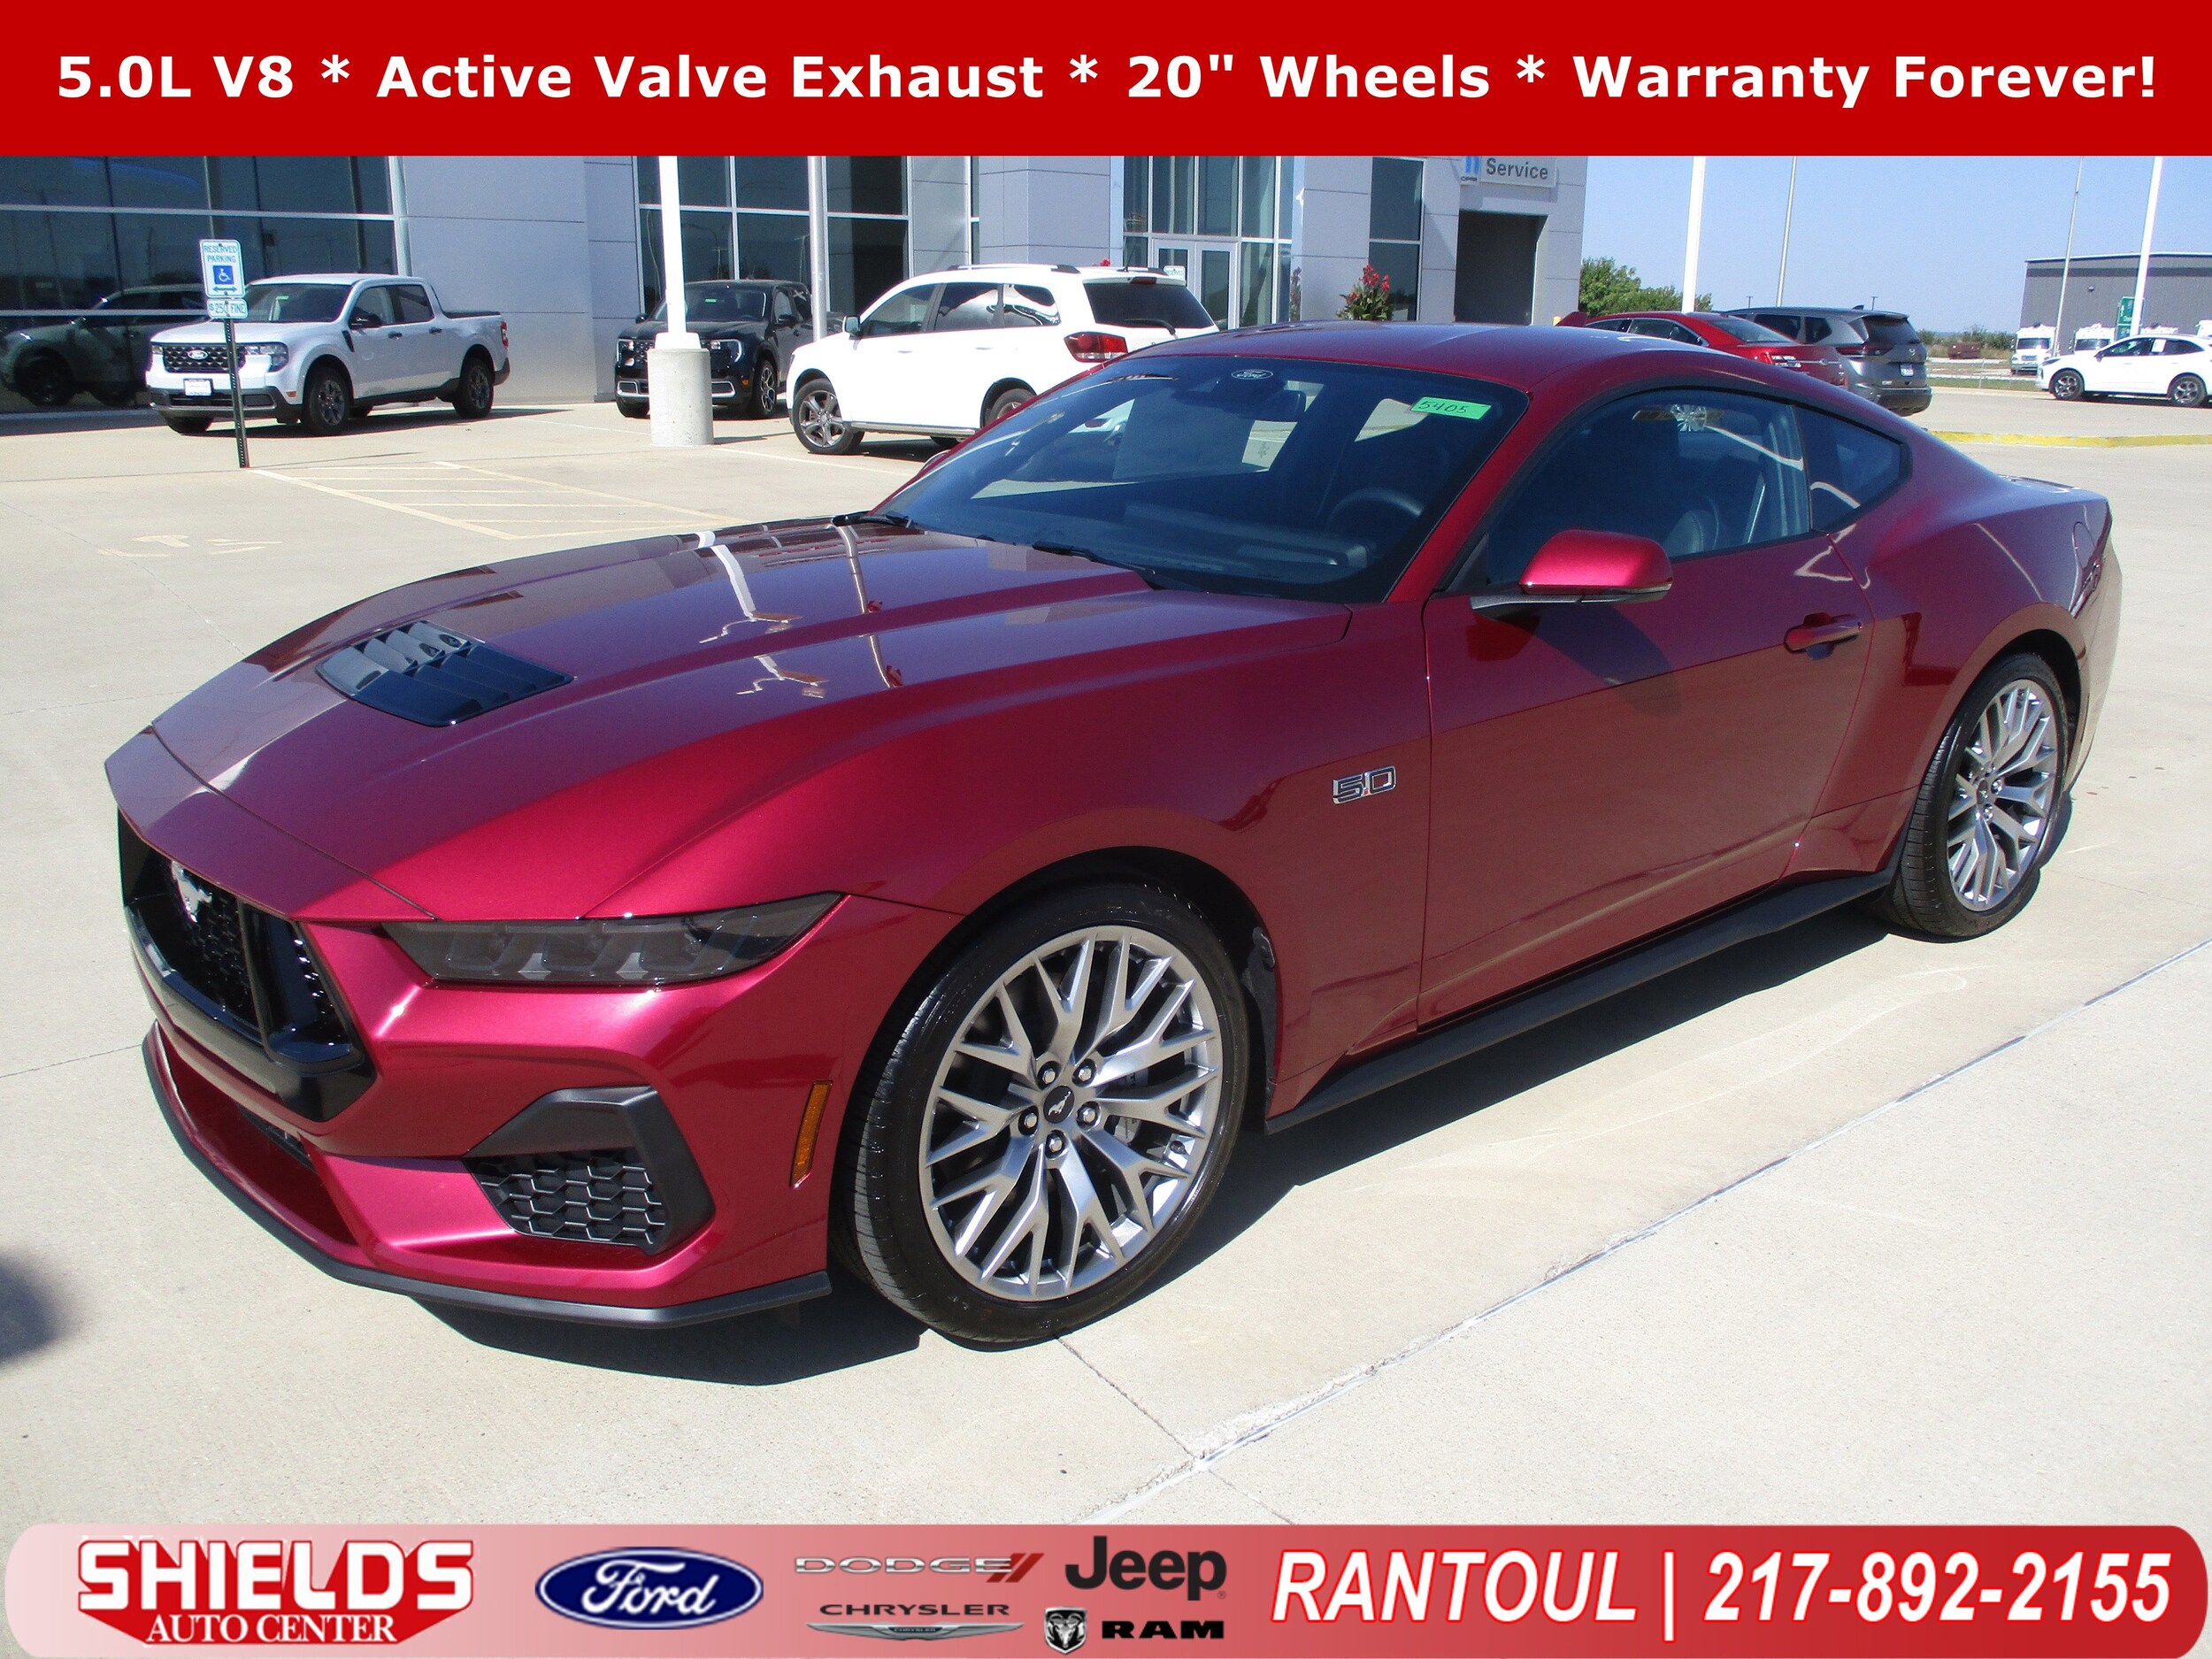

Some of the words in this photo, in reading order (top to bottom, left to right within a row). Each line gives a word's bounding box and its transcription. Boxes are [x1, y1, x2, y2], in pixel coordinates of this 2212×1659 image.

[1486, 157, 1548, 180] Service
[204, 244, 238, 254] RESERVED
[207, 255, 236, 264] PARKING
[1418, 401, 1467, 414] 5405
[1333, 765, 1397, 804] 5.0
